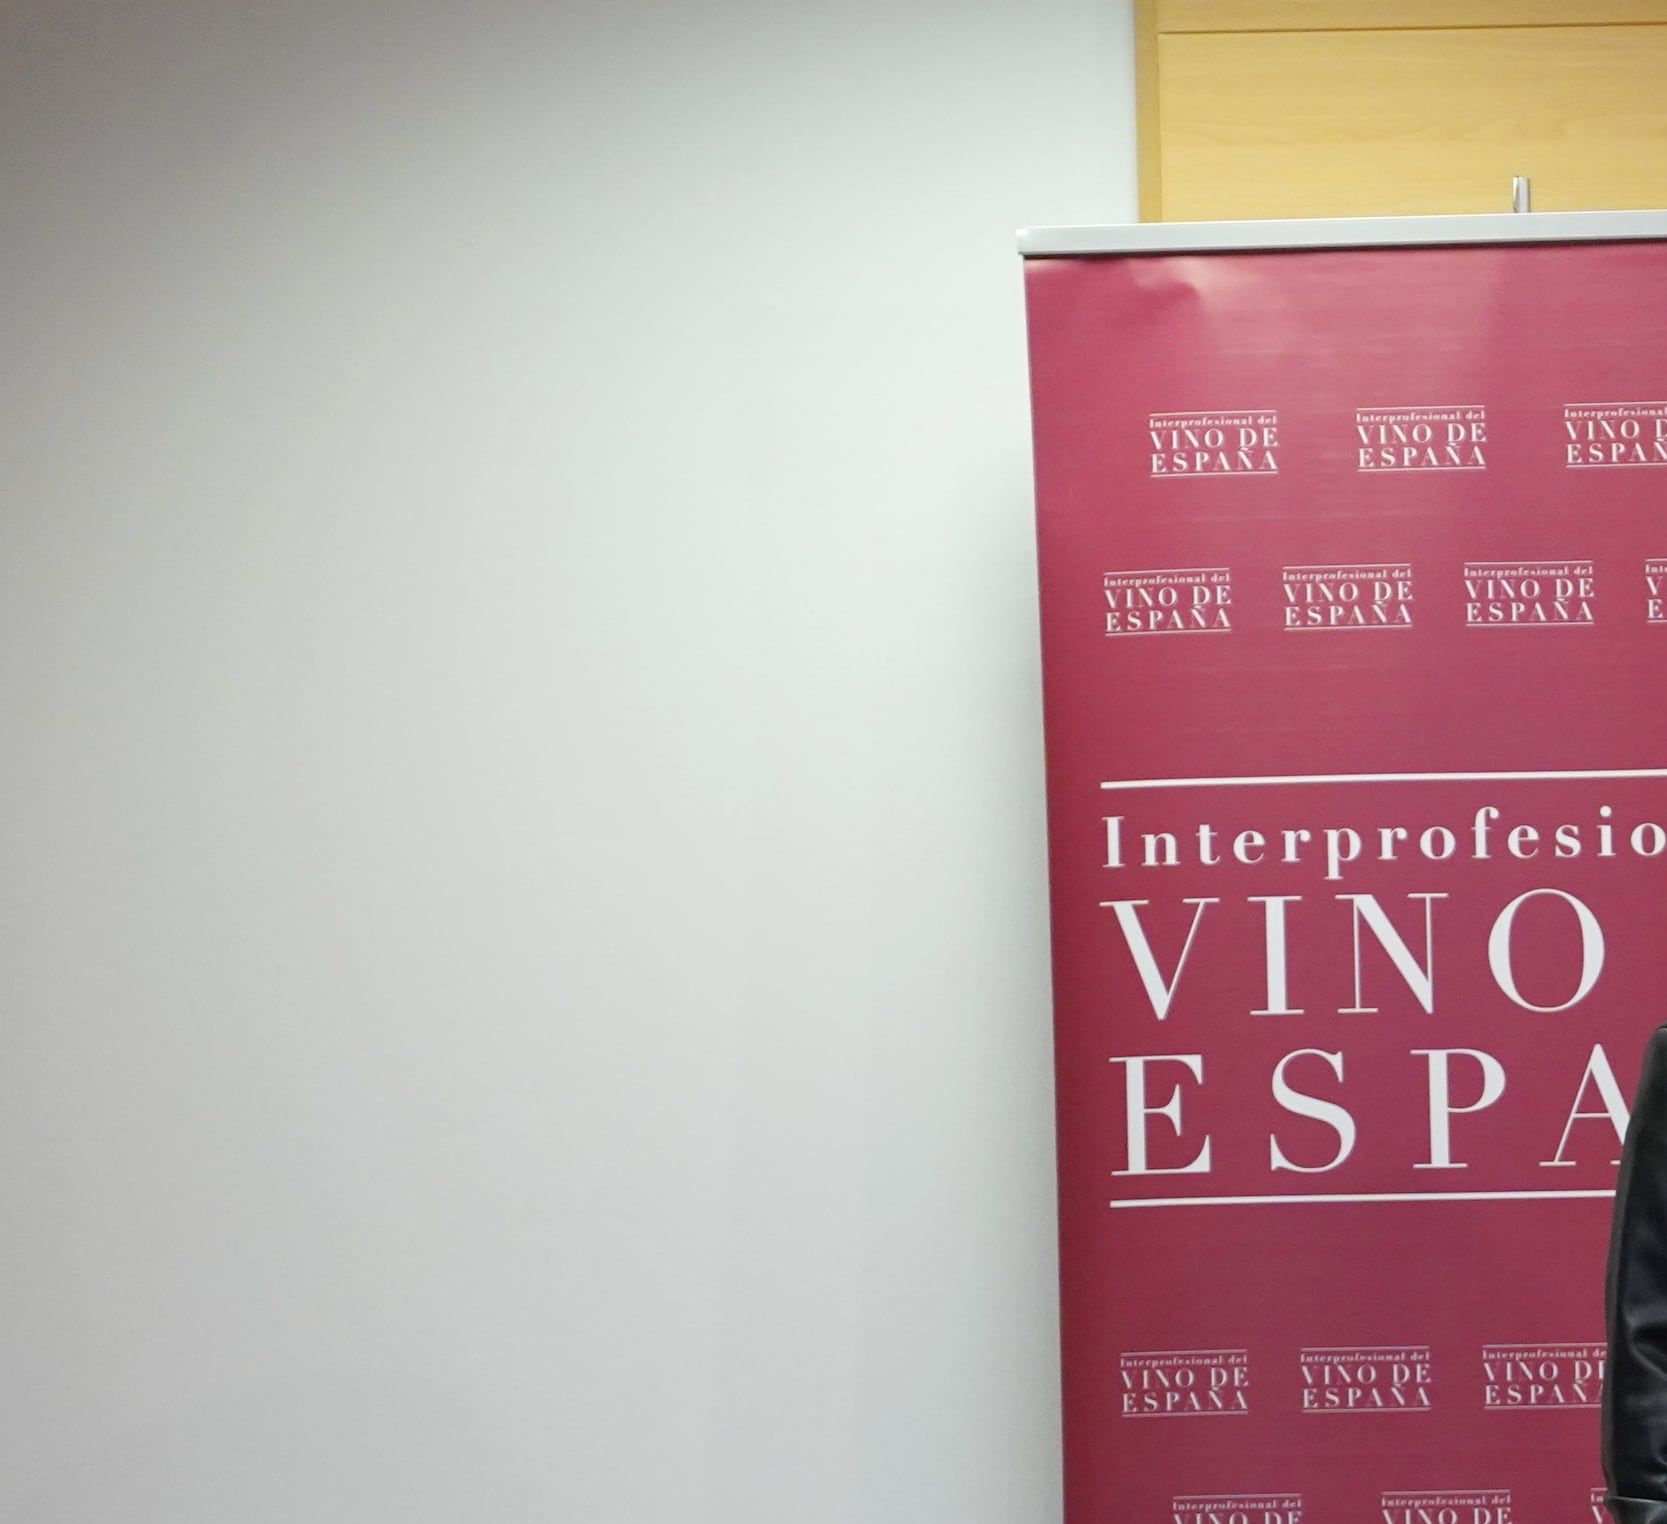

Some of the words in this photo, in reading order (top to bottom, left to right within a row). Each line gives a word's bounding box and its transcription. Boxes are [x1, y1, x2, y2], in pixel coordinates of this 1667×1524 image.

[1149, 415, 1252, 429] Interprofesional
[1257, 415, 1278, 425] del
[1356, 410, 1460, 424] Interprofesional
[1465, 410, 1486, 420] del
[1564, 406, 1667, 419] Interprofesional
[1150, 428, 1224, 450] VINO
[1239, 428, 1278, 448] DE
[1357, 423, 1432, 445] VINO
[1447, 423, 1487, 443] DE
[1565, 418, 1640, 441] VINO
[1152, 448, 1278, 473] ESPAÑA
[1359, 443, 1487, 468] ESPAÑA
[1104, 573, 1205, 588] Interprofesional
[1210, 573, 1231, 583] del
[1283, 569, 1387, 582] Interprofesional
[1392, 569, 1413, 579] del
[1464, 566, 1568, 578] Interprofesional
[1573, 566, 1594, 576] del
[1105, 586, 1178, 609] VINO
[1192, 585, 1231, 606] DE
[1284, 581, 1358, 603] VINO
[1374, 581, 1413, 602] DE
[1465, 578, 1540, 599] VINO
[1555, 579, 1595, 599] DE
[1106, 606, 1231, 632] ESPAÑA
[1286, 602, 1413, 626] ESPAÑA
[1467, 599, 1595, 622] ESPAÑA
[1099, 888, 1605, 1022] VINO
[1121, 1367, 1195, 1390] VINO
[1210, 1367, 1249, 1388] DE
[1301, 1363, 1376, 1385] VINO
[1392, 1364, 1432, 1384] DE
[1484, 1360, 1558, 1382] VINO
[1123, 1388, 1249, 1413] ESPAÑA
[1303, 1384, 1432, 1408] ESPAÑA
[1486, 1379, 1603, 1405] ESPAÑ
